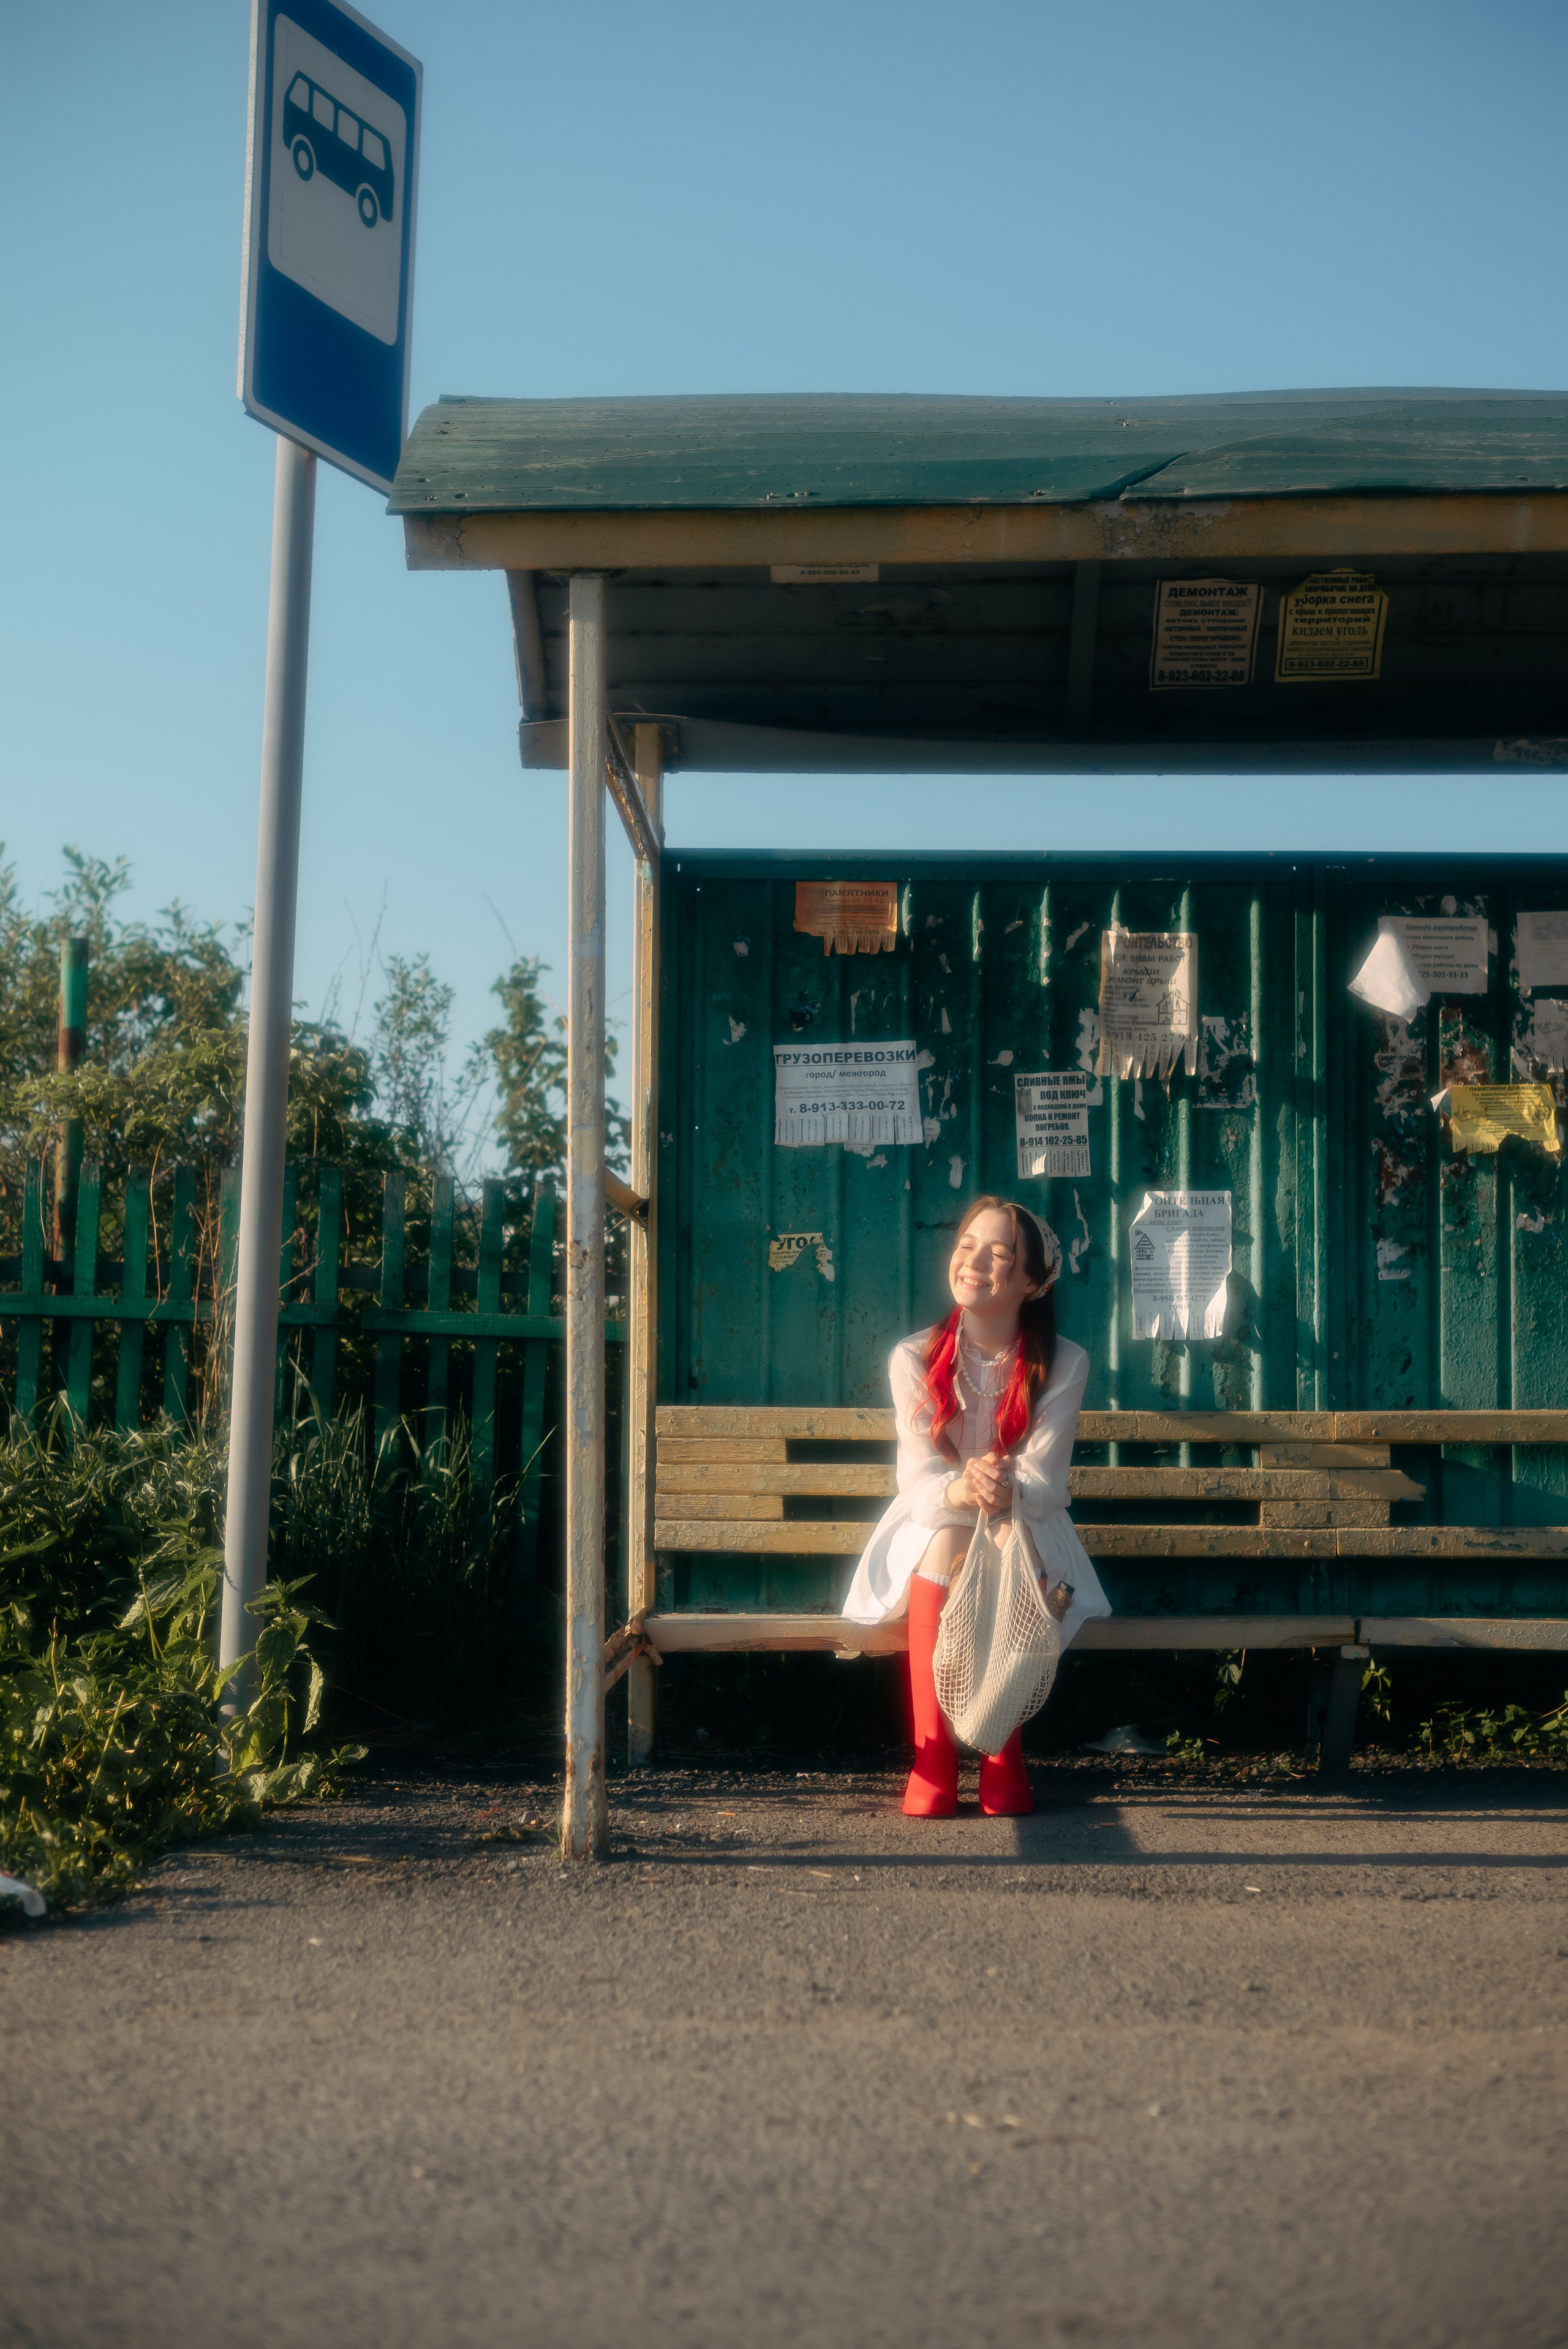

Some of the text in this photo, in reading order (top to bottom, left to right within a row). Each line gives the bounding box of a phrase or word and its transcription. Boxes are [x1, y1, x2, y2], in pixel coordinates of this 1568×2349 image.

[1168, 587, 1248, 598] ДЕМОНТАЖ
[1294, 594, 1375, 608] уборка снега
[1294, 615, 1371, 625] территорий
[1292, 626, 1369, 640] кидаем уголь
[1289, 660, 1365, 669] 8-923-602-22-88
[1158, 669, 1246, 682] 8-923-602-22-88
[1130, 954, 1156, 963] ВИДЫ
[1107, 976, 1144, 985] РЕМОНТ
[1136, 1032, 1157, 1042] 425
[1161, 1033, 1174, 1042] 27
[1178, 1033, 1193, 1043] 93
[775, 1049, 916, 1065] ГРУЗОПЕРЕВОЗКИ
[805, 1069, 888, 1080] город/ межгород
[1017, 1075, 1086, 1088] СЛИВНЫЕ ЯМЫ
[1040, 1090, 1086, 1101] ПОД КЛЮЧ
[799, 1101, 906, 1114] 8-913-333-00-72
[1054, 1112, 1081, 1121] РЕМОНТ
[1035, 1123, 1071, 1131] ПОГРЕБОВ.
[1020, 1135, 1088, 1147] 8-914 102-25-85
[1153, 1196, 1226, 1206] ОИТЕЛЬНАЯ
[1155, 1208, 1204, 1218] БРИГАДА
[777, 1236, 822, 1251] УГО
[1153, 1294, 1207, 1303] 8-950-587-4272
